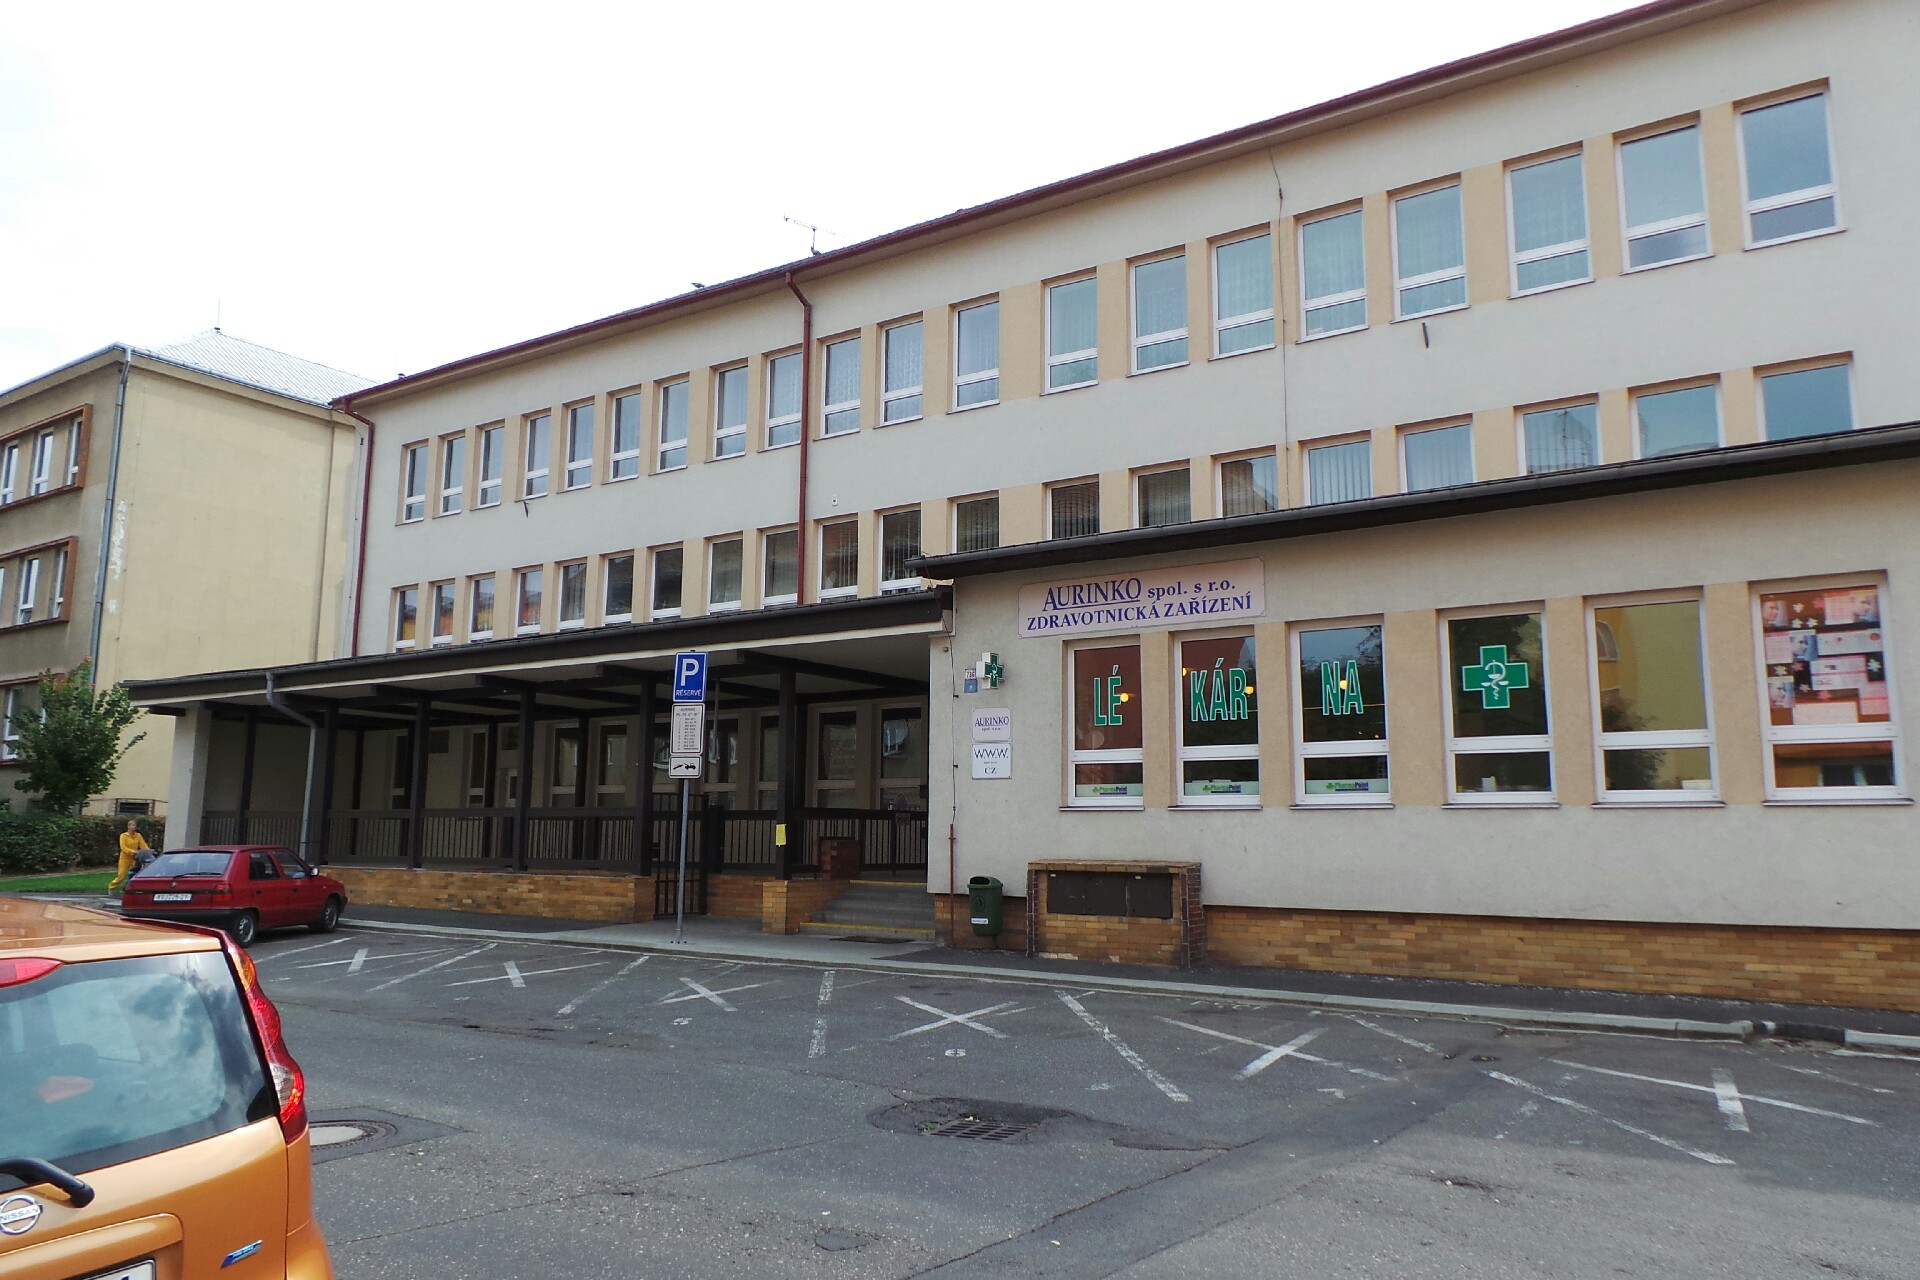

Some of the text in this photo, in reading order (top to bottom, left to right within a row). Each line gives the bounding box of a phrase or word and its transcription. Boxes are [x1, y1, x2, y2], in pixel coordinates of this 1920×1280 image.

[1042, 578, 1236, 612] AURINKO spol. s r.o.
[1027, 592, 1252, 631] ZDRAVOTNICKÁ ZAŘÍZENÍ
[681, 658, 700, 687] P
[1094, 658, 1364, 726] LÉ KÁR NA
[974, 716, 1009, 727] AURINKO
[984, 766, 997, 774] CZ
[0, 1208, 39, 1221] NISSAN
